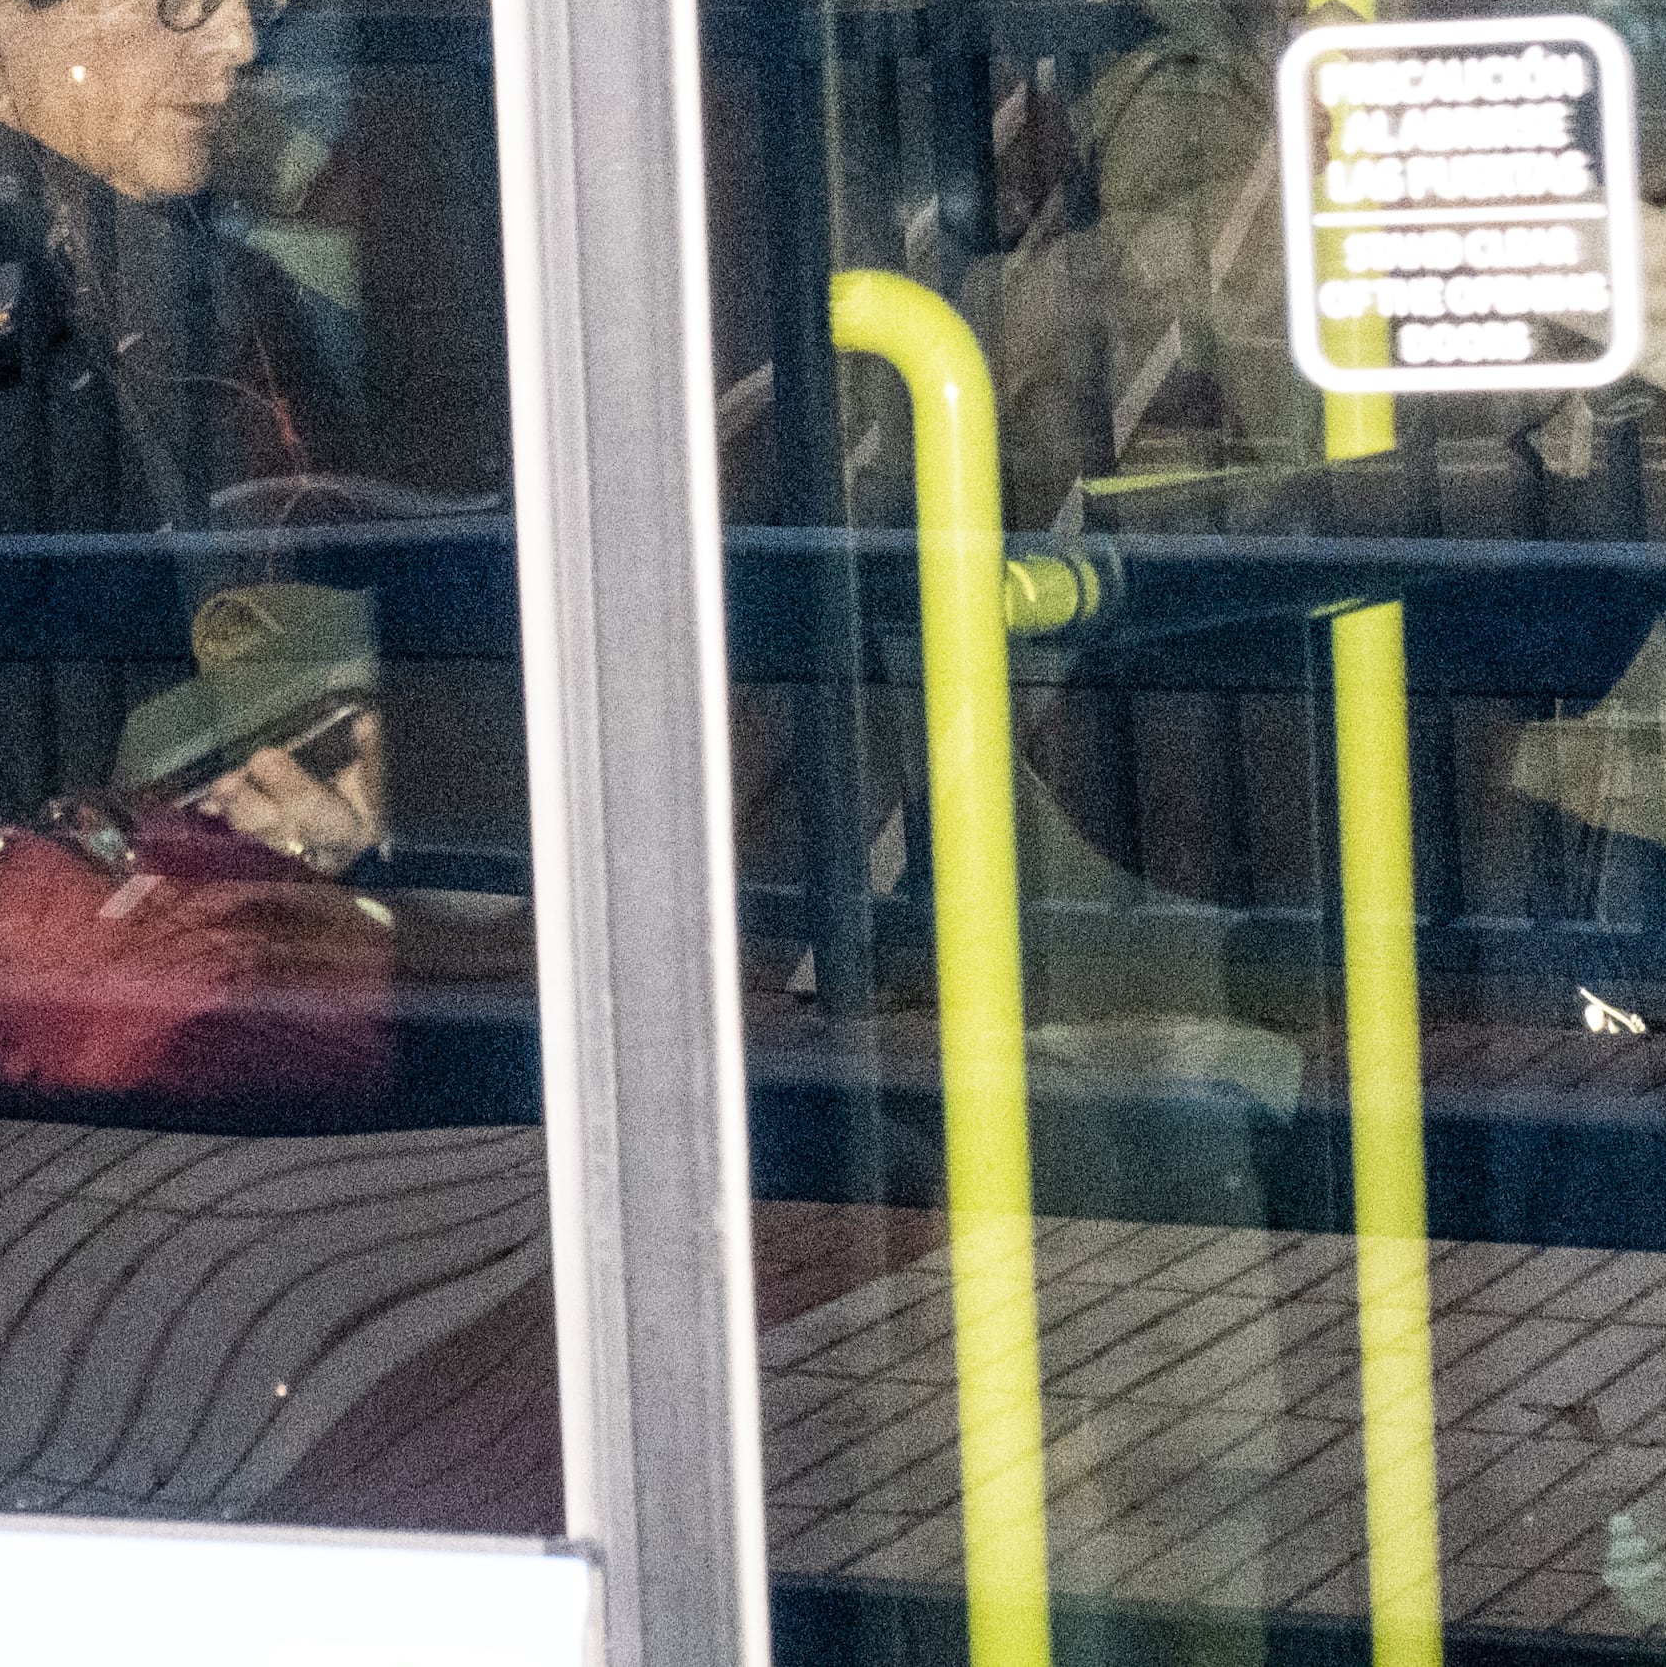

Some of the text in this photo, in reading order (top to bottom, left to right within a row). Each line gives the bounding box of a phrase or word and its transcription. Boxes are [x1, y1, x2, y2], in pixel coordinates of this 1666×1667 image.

[1327, 150, 1590, 203] LAS PUERTAS
[1400, 321, 1531, 363] DOORS
